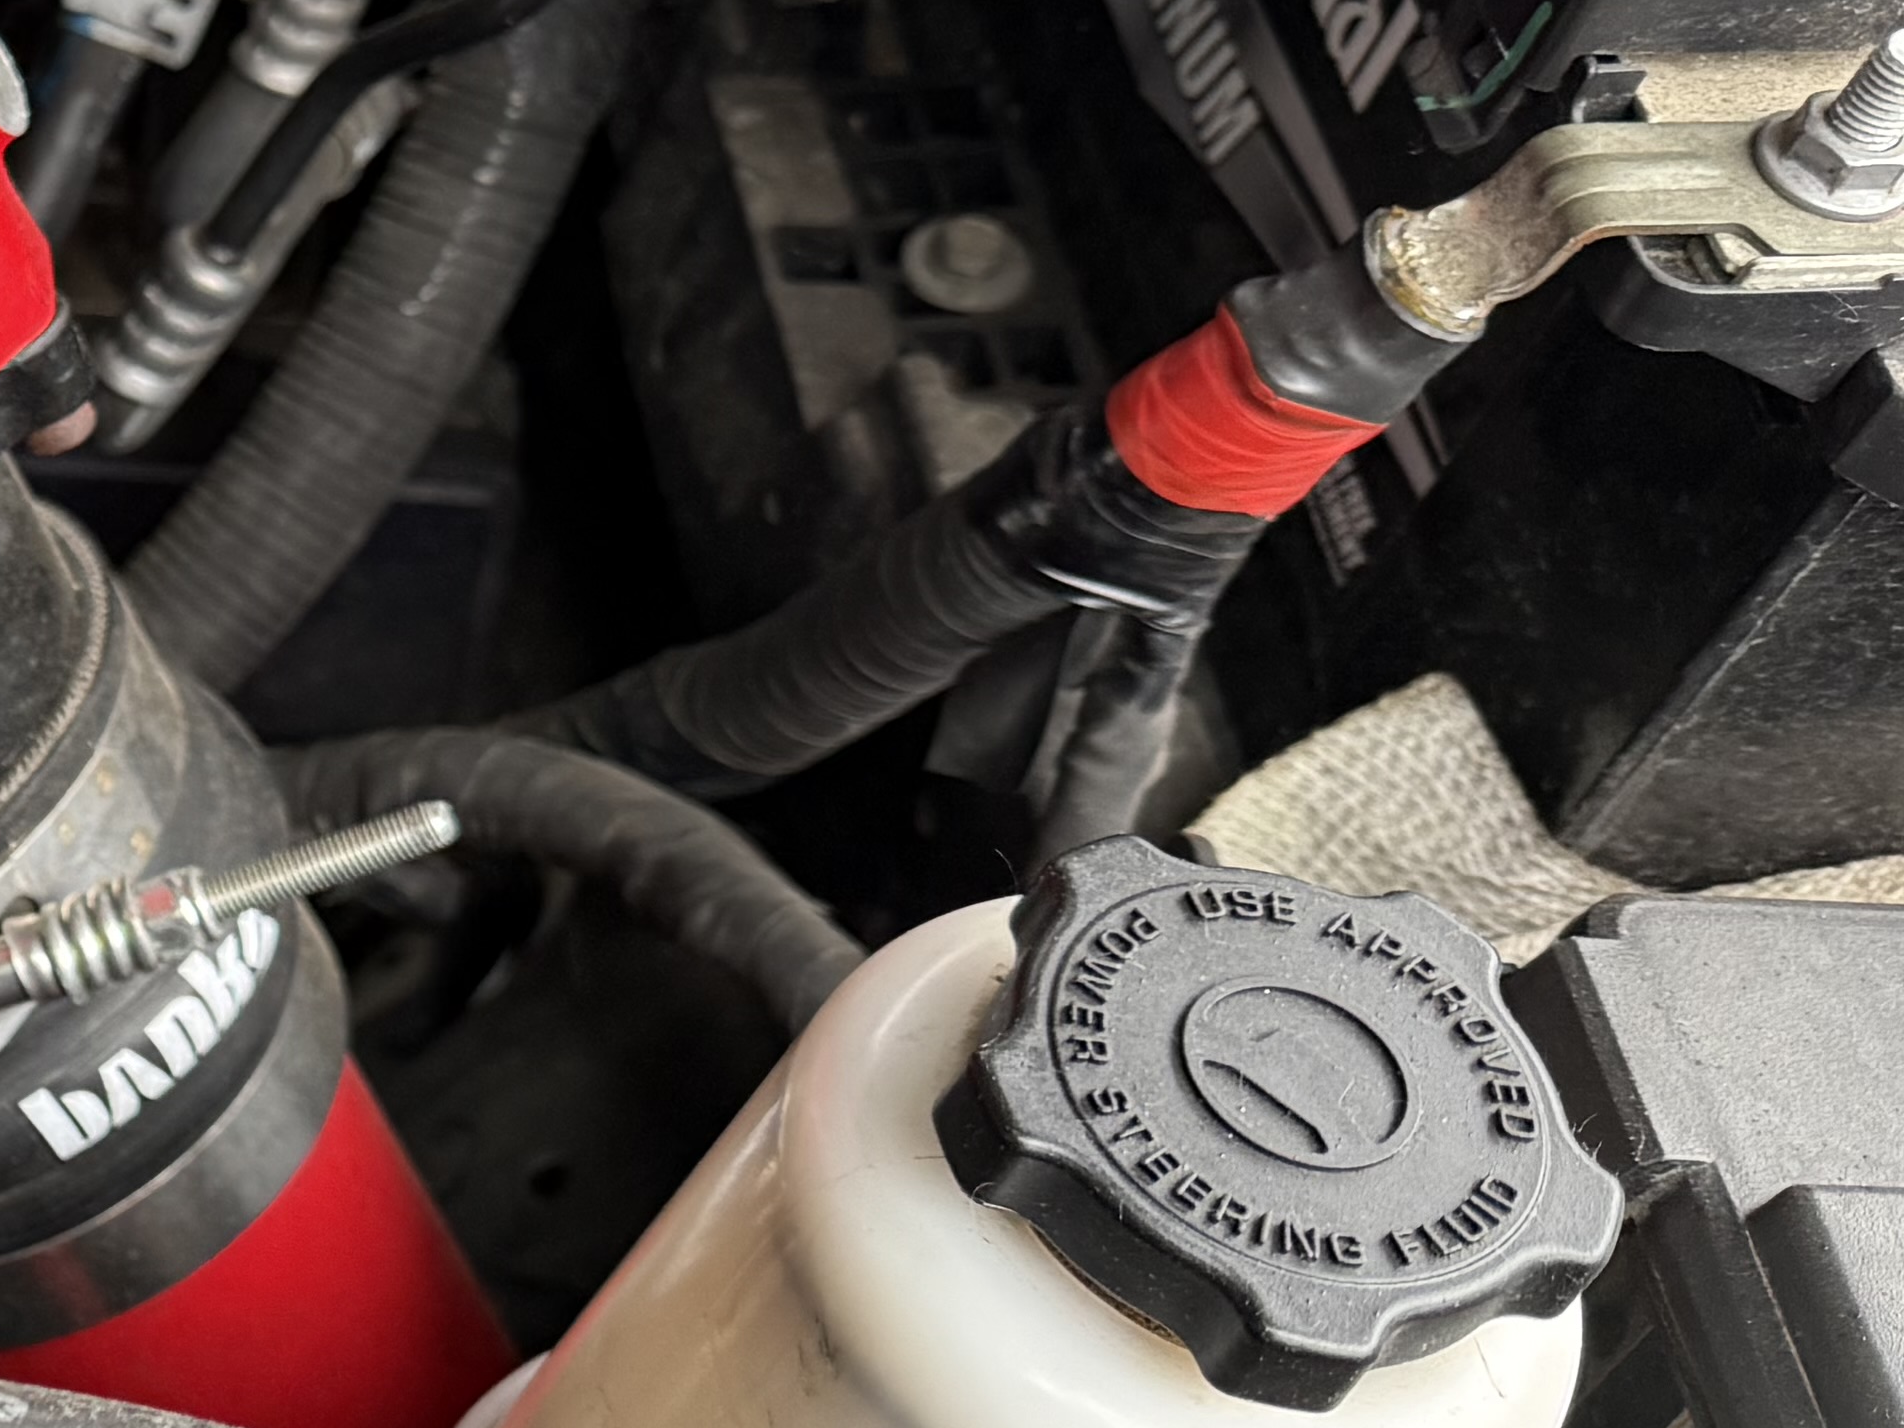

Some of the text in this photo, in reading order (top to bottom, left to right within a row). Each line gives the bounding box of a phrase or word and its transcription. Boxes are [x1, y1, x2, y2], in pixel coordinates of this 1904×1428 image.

[1058, 908, 1522, 1269] POWER STEERING FLUID
[1185, 883, 1540, 1145] USE APPROVED
